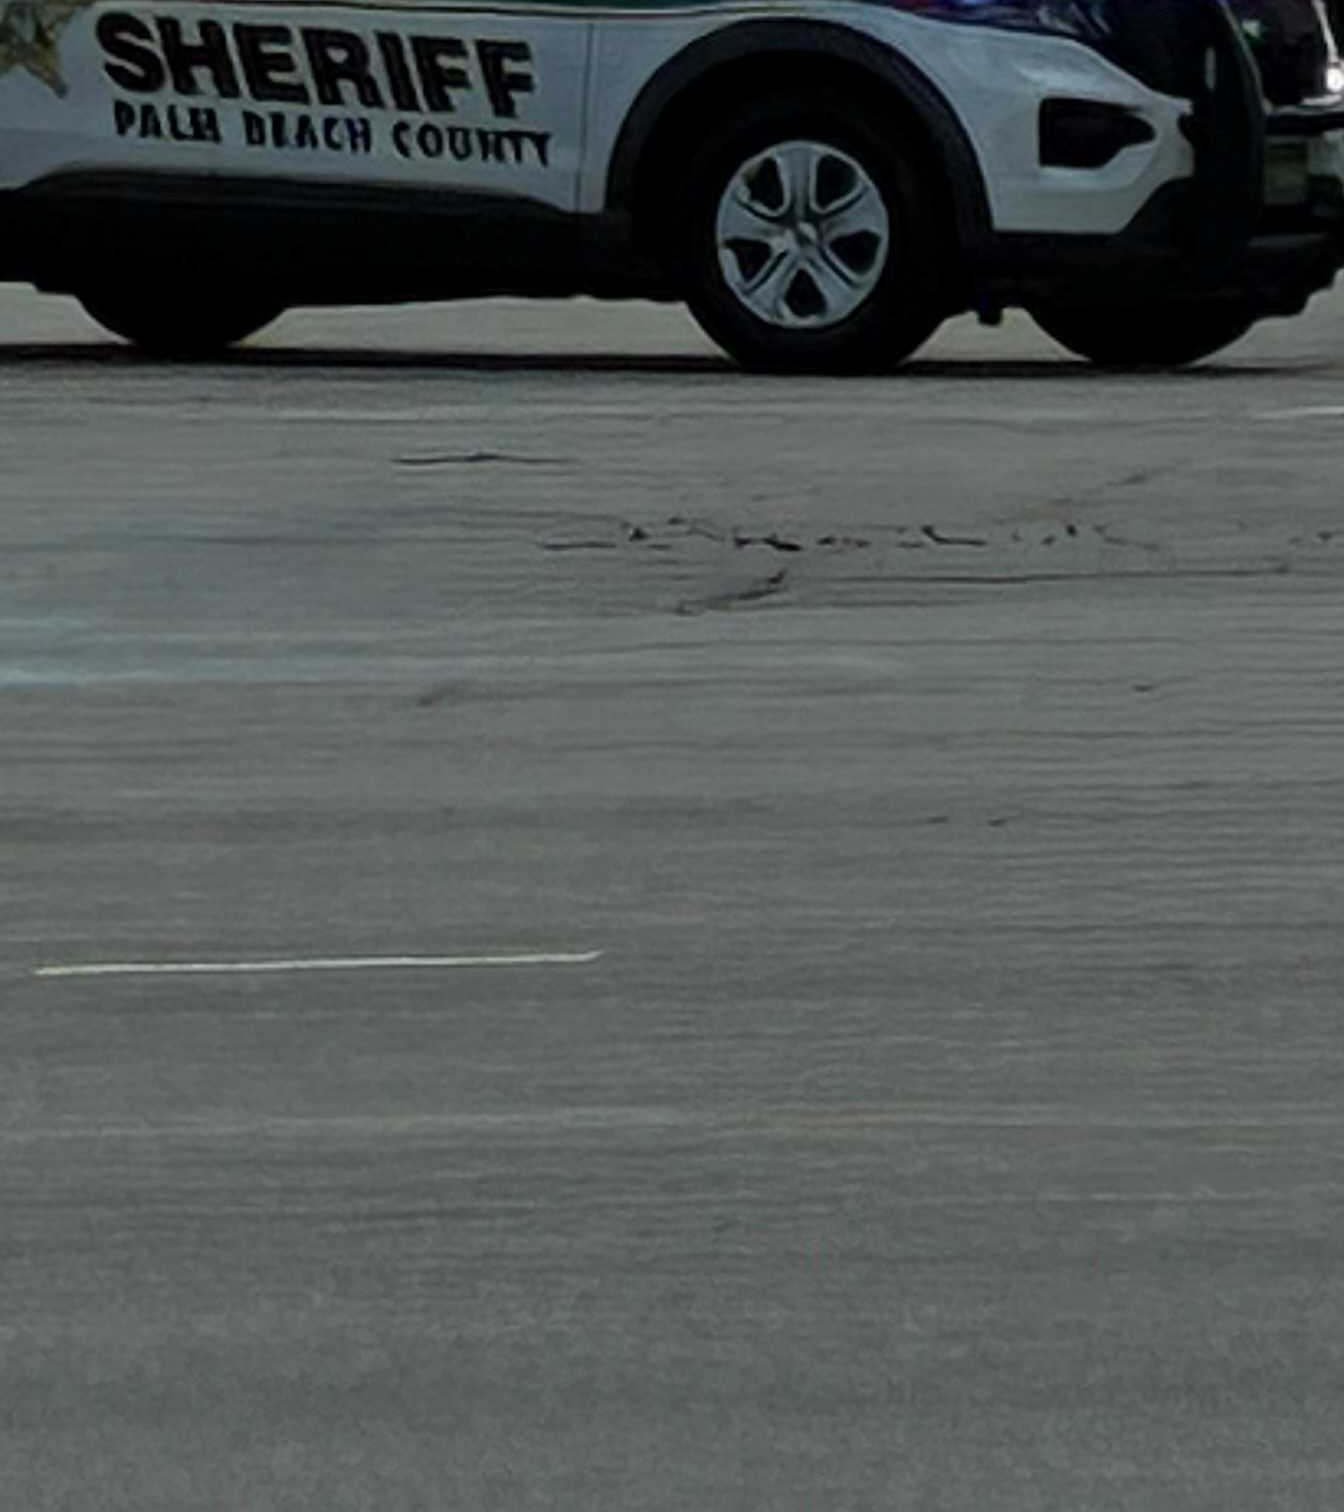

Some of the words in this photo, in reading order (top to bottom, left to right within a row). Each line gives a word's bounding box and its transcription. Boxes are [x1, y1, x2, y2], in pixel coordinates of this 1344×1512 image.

[96, 12, 535, 118] SHERIFF
[113, 100, 223, 144] PALM
[242, 110, 372, 152] BEACH
[392, 120, 552, 167] COUNTY
